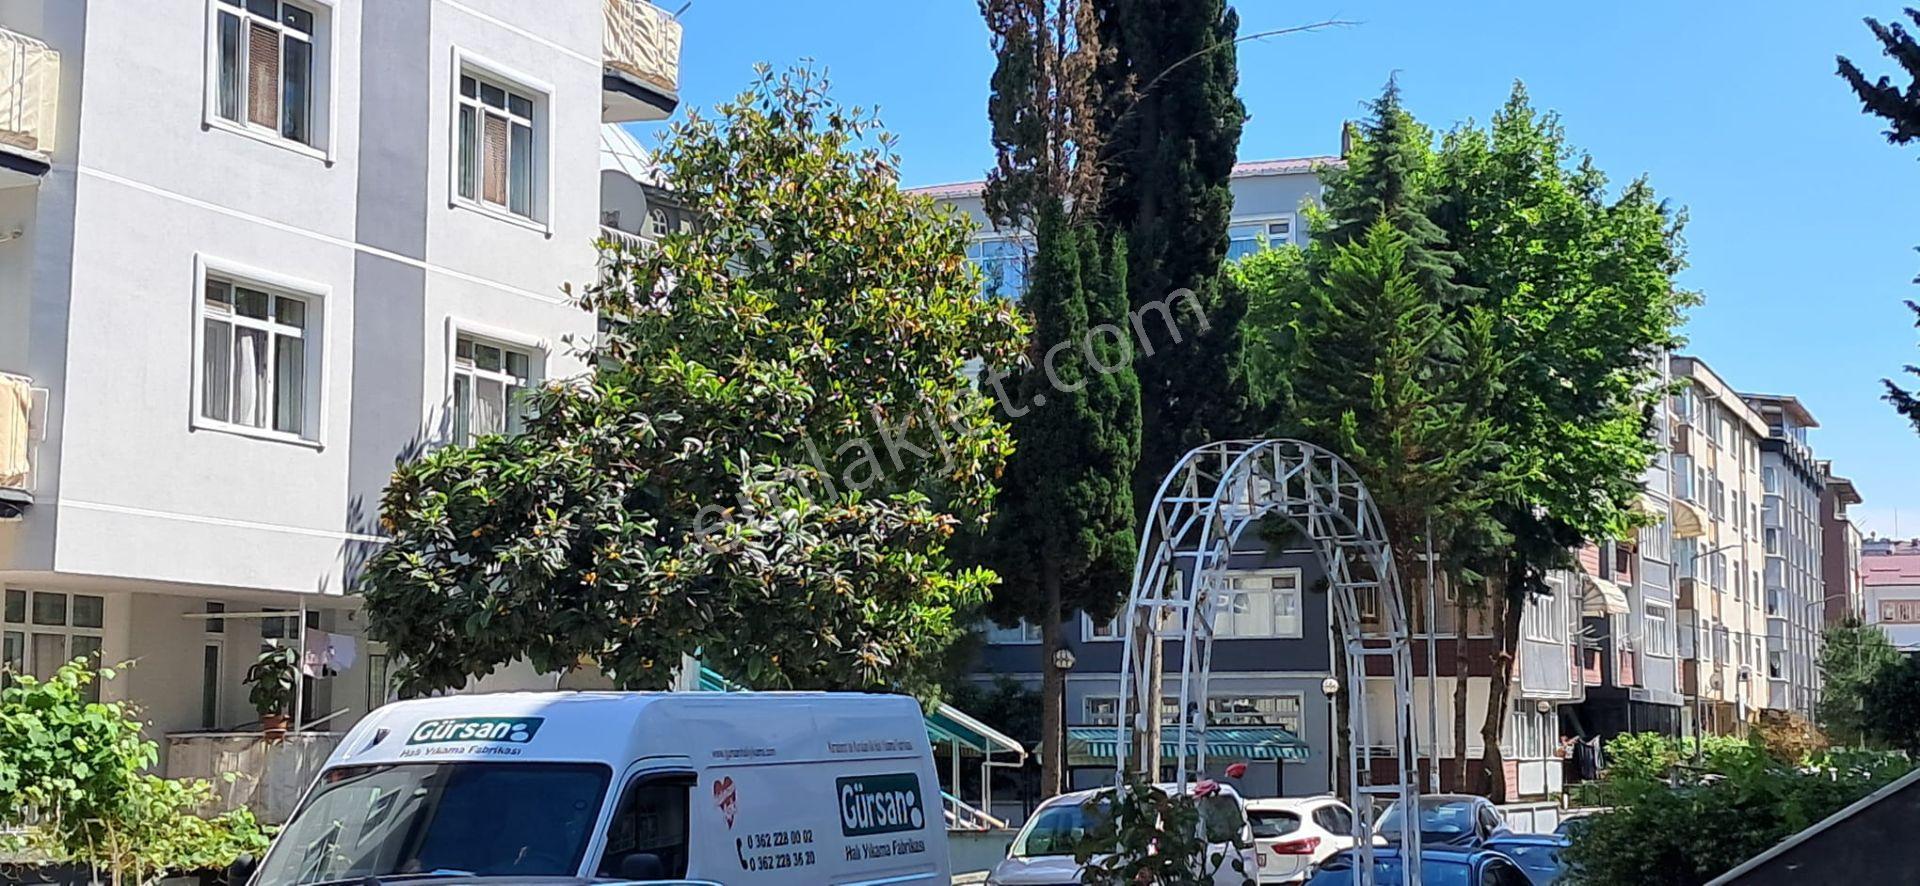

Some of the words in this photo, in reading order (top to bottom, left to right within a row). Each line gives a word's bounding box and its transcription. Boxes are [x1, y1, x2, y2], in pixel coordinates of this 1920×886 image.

[413, 720, 512, 741] Gürsan
[841, 782, 909, 829] Gürsan
[747, 835, 754, 849] 0
[755, 833, 772, 848] 362
[749, 857, 756, 872] 0
[758, 855, 774, 871] 362
